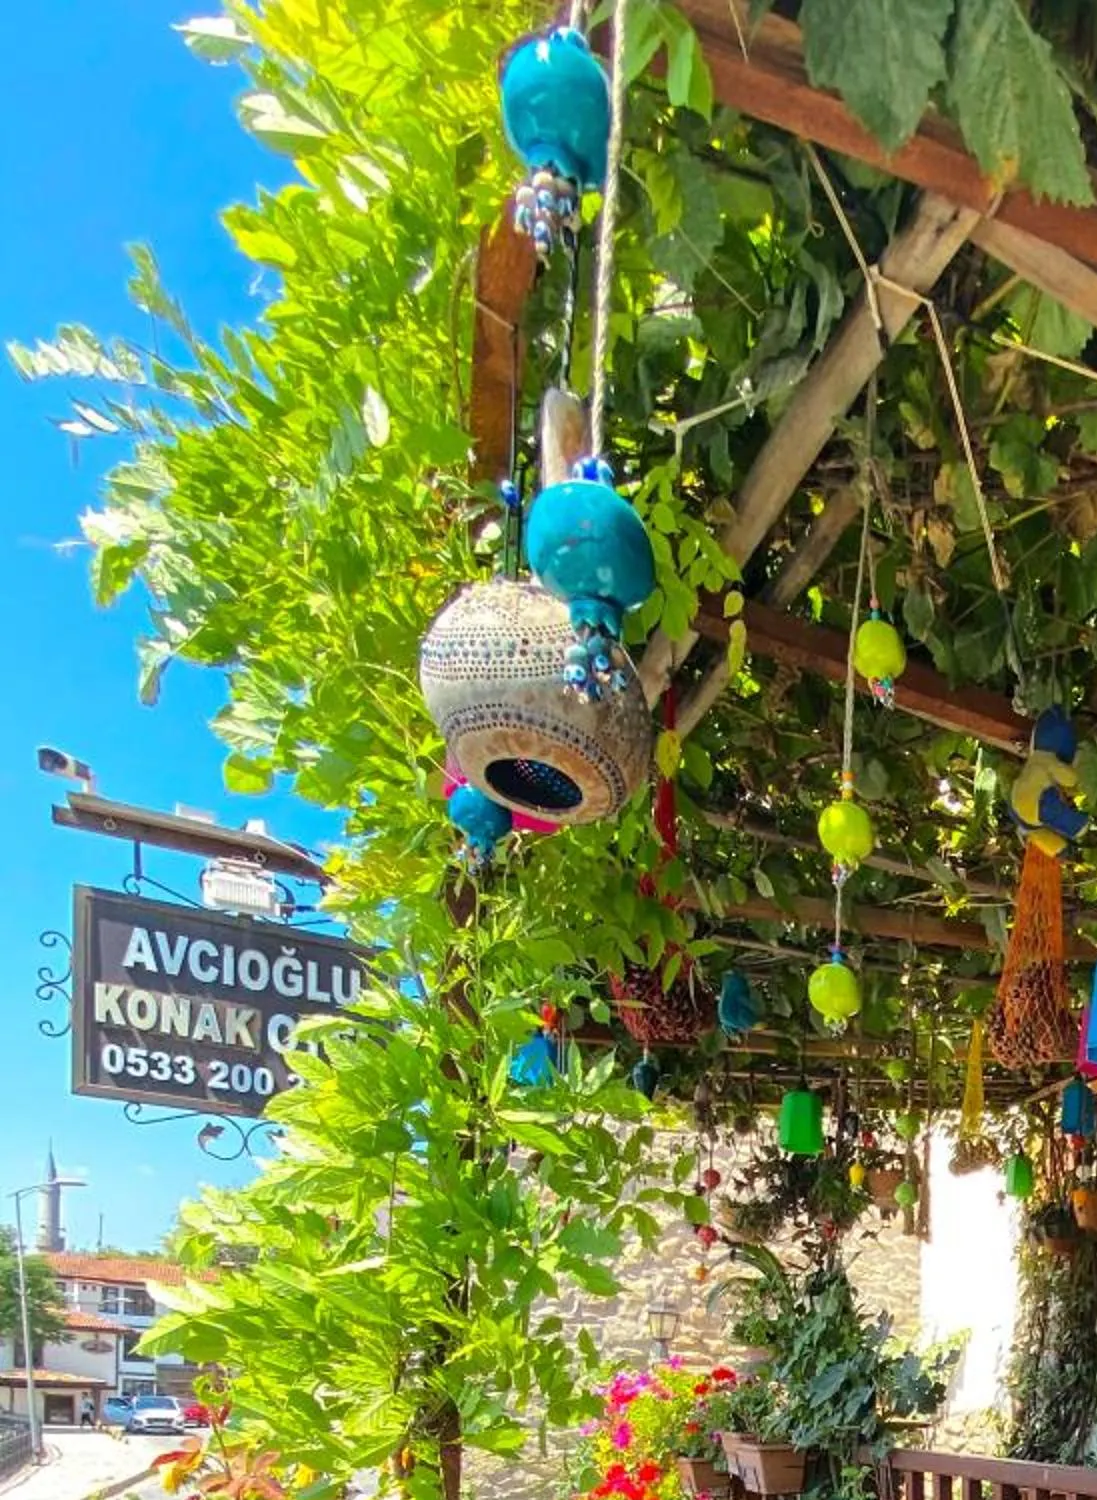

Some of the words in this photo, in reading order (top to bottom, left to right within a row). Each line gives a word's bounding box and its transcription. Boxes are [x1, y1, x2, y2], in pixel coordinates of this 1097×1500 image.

[122, 927, 361, 1006] AVCIOĞLU
[94, 982, 257, 1049] KONAK
[101, 1043, 196, 1085] 0533
[207, 1060, 274, 1095] 200
